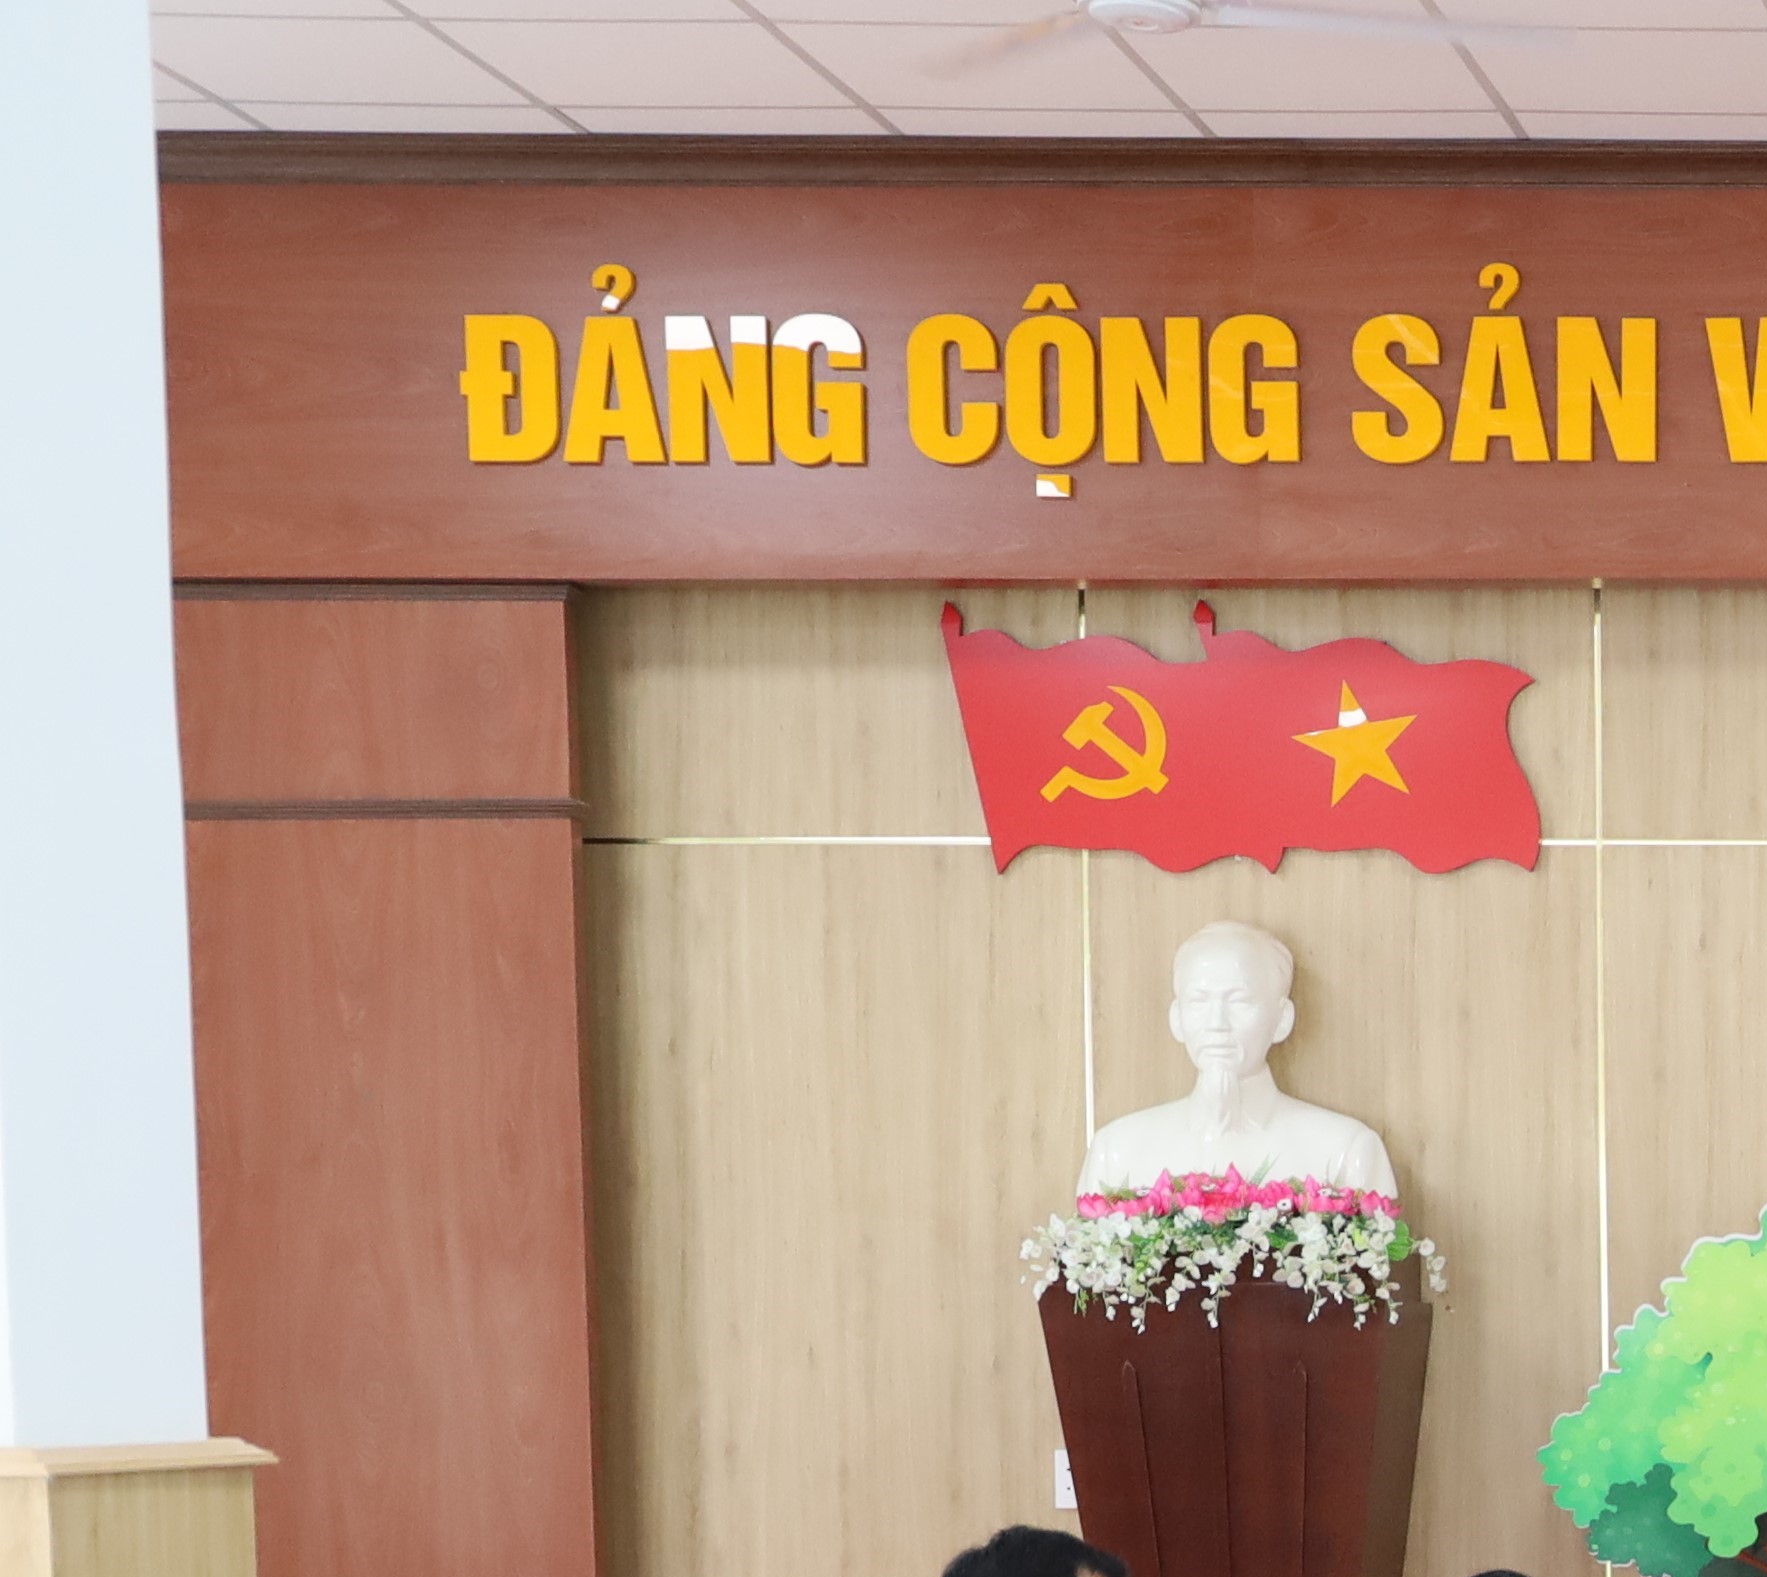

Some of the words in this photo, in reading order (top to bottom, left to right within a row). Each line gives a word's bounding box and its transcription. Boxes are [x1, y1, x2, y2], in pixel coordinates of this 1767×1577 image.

[459, 264, 865, 466] ĐẢNG
[906, 284, 1301, 498] CỘNG
[1351, 263, 1657, 465] SẢN
